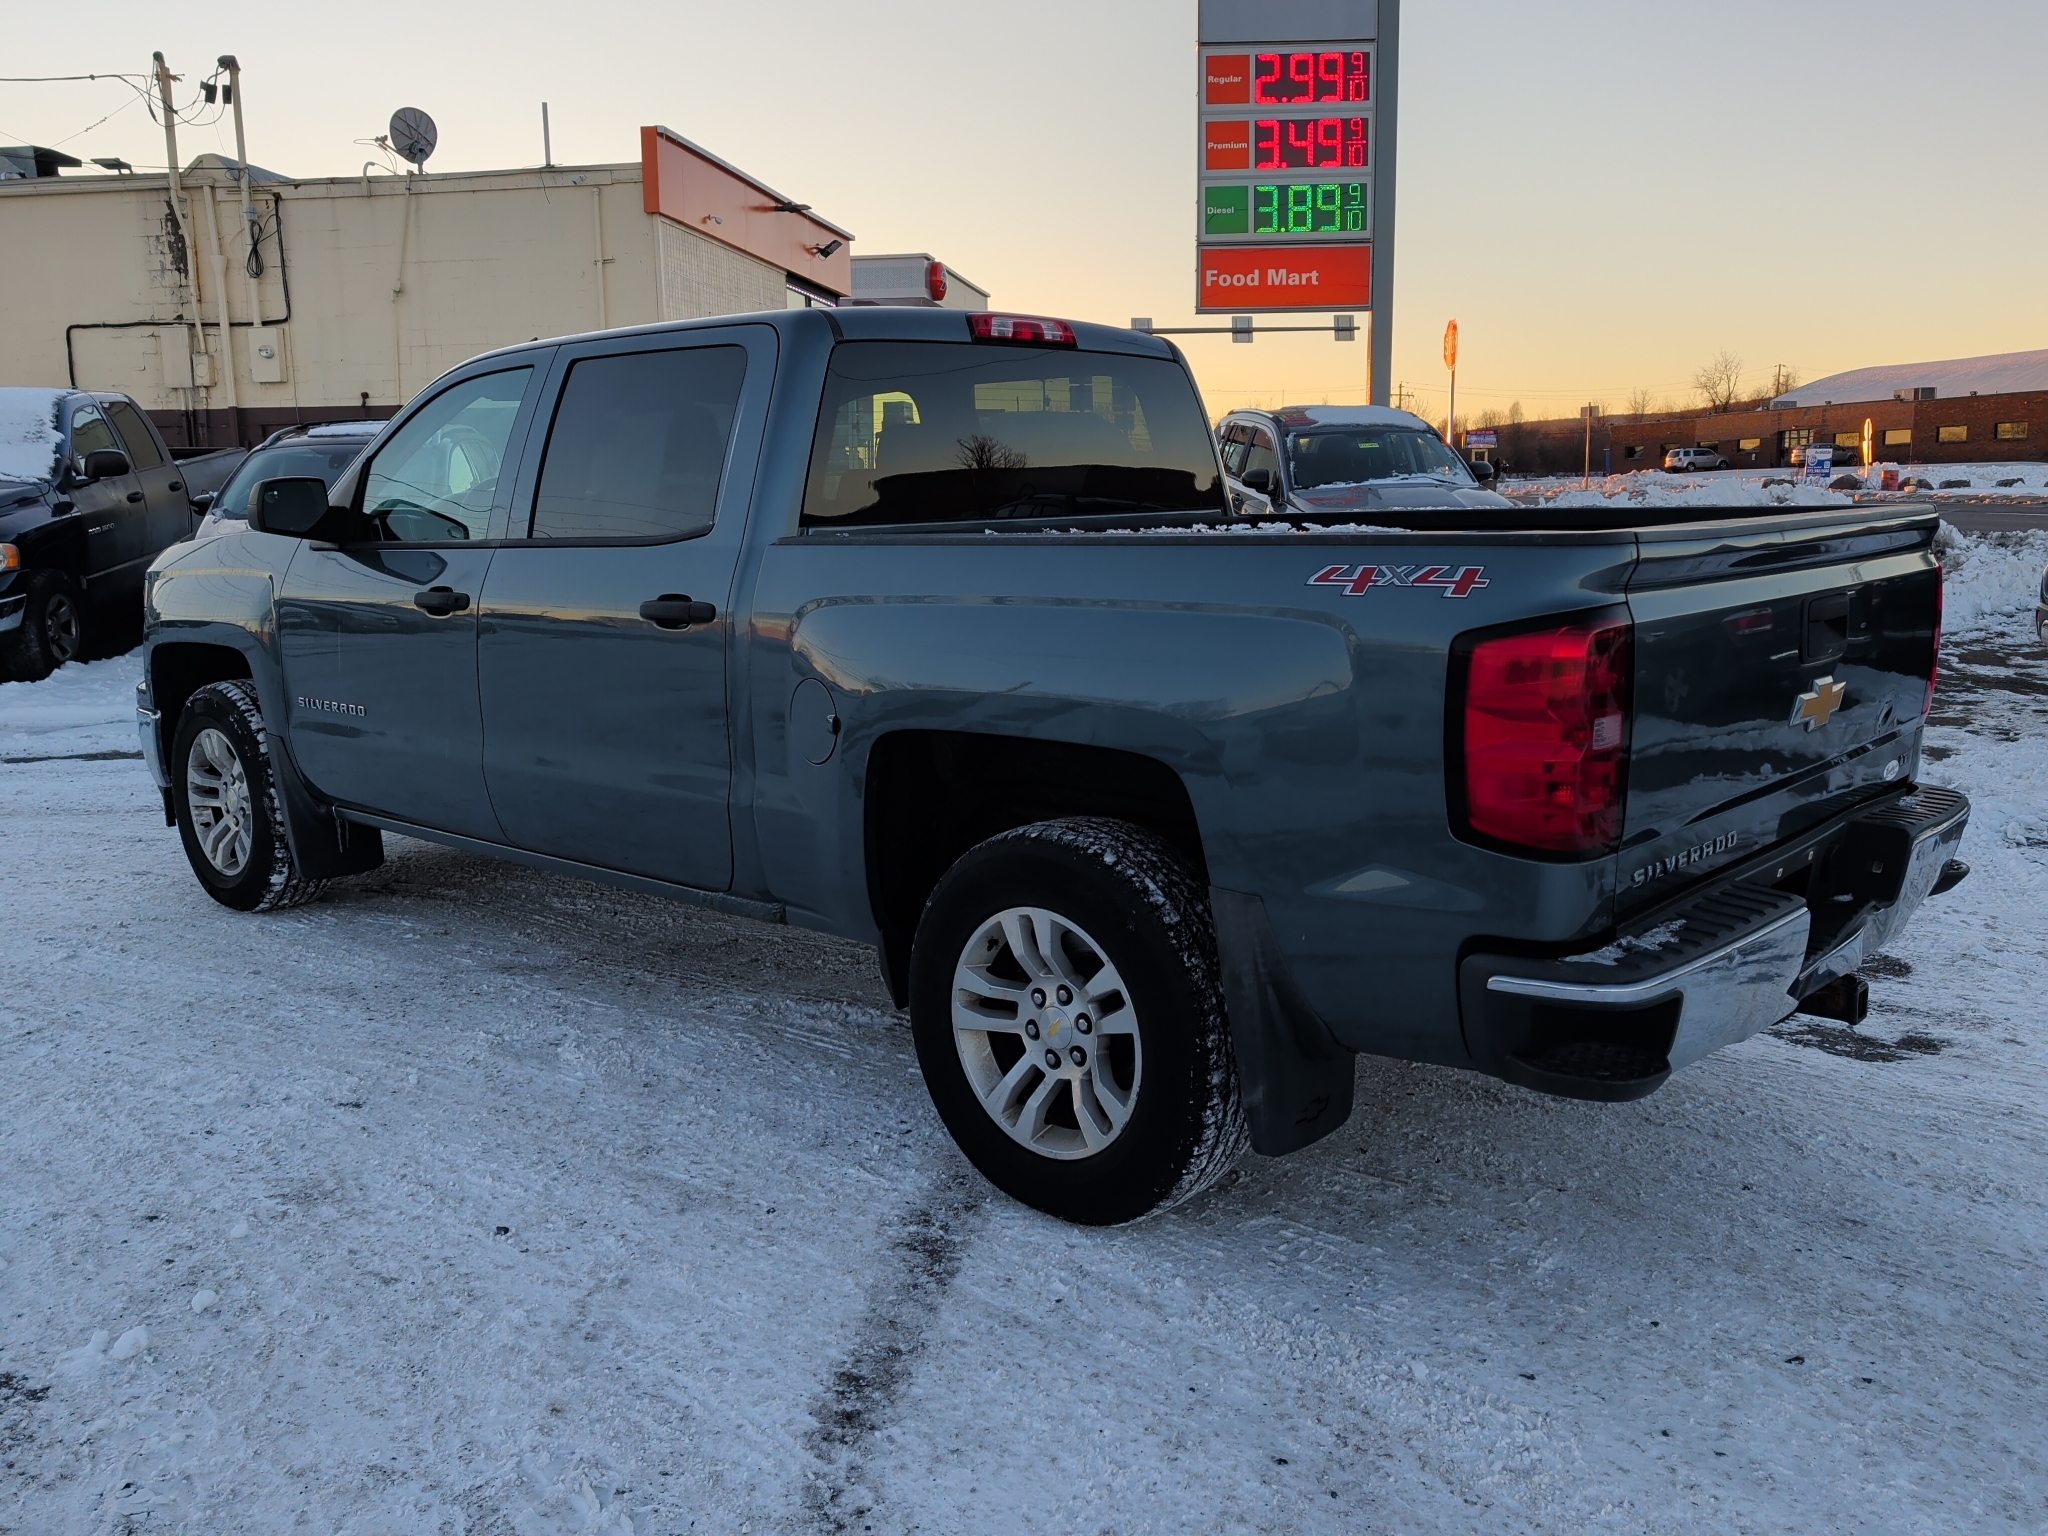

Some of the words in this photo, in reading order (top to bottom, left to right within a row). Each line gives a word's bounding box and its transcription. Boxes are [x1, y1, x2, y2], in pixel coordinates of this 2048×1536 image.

[1351, 52, 1363, 74] 9
[1207, 75, 1242, 85] Regular
[1255, 53, 1344, 104] 2.99
[1349, 78, 1366, 102] 10
[1350, 117, 1362, 139] 9
[1207, 141, 1248, 150] Premium
[1256, 118, 1342, 170] 3.49
[1348, 144, 1363, 167] 10
[1349, 183, 1361, 205] 9
[1207, 206, 1235, 215] Diesel
[1256, 184, 1341, 233] 3.89
[1346, 210, 1362, 232] 10
[1205, 269, 1260, 287] Food
[1267, 269, 1319, 286] Mart
[298, 696, 366, 717] SILVERADO
[1631, 830, 1737, 889] SILVERADO
